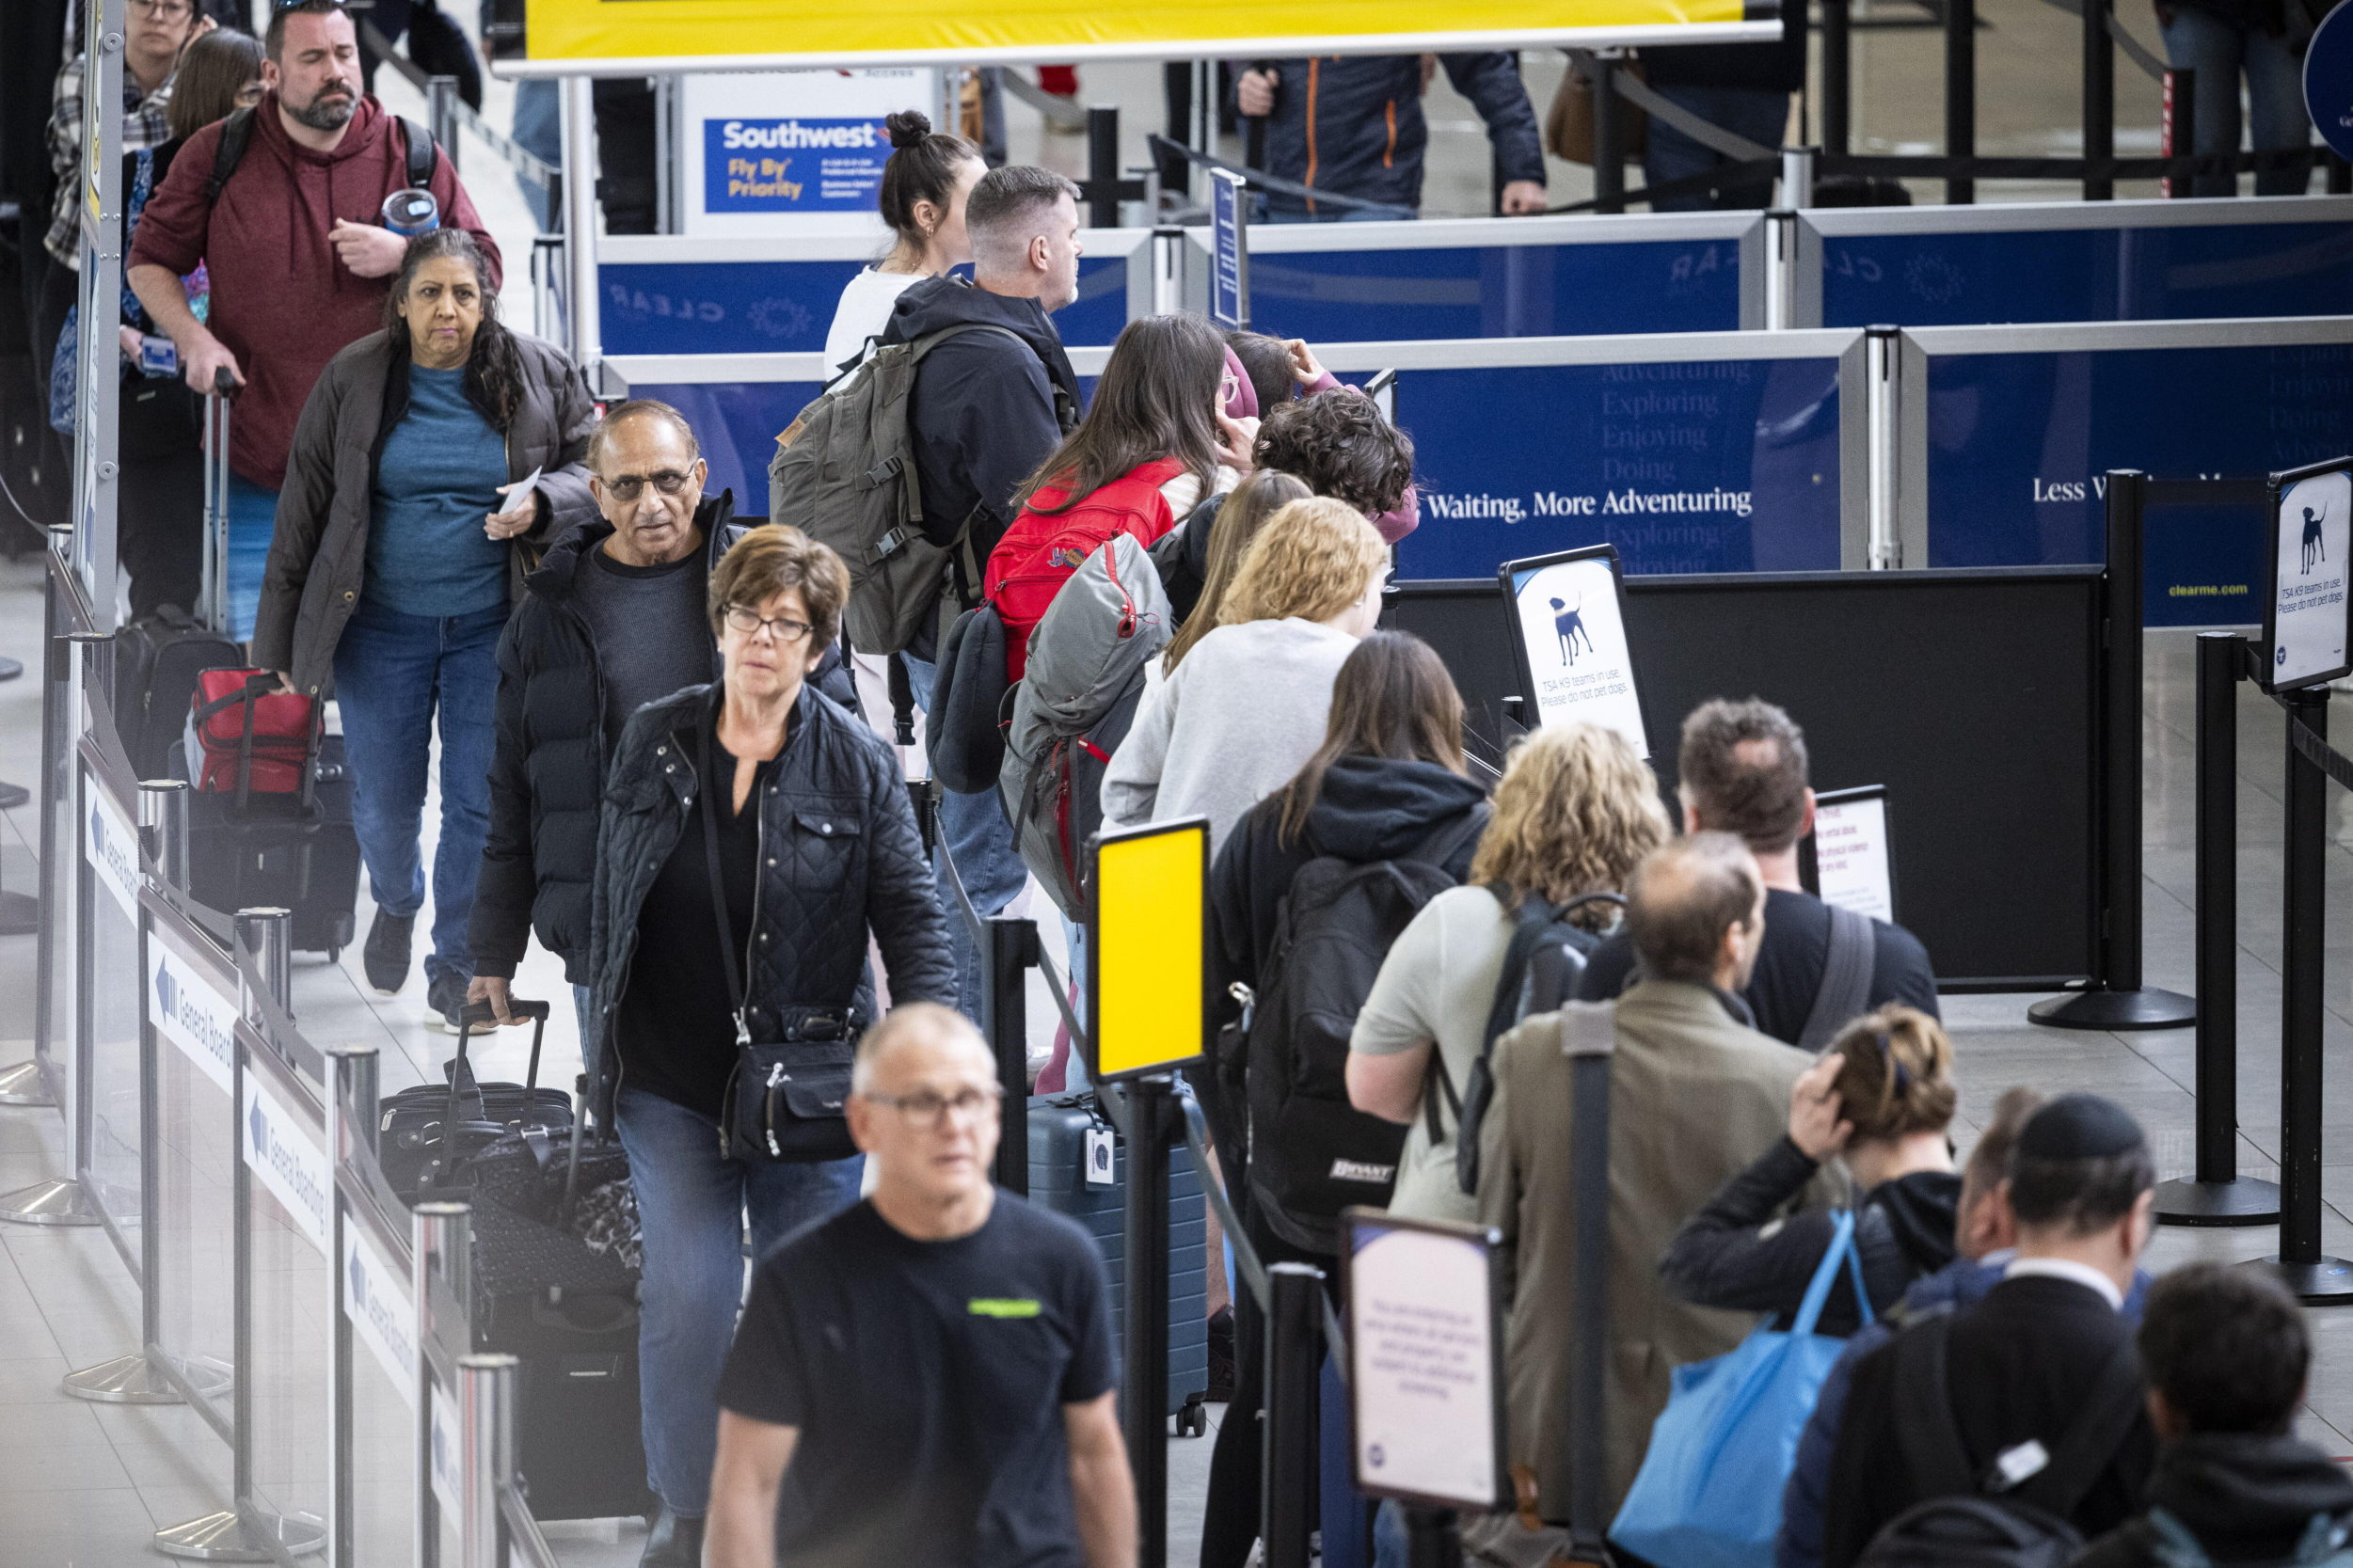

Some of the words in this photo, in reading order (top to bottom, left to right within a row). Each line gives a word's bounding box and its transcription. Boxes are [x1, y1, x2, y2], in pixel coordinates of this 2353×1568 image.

[723, 120, 877, 149] Southwest
[728, 158, 757, 180] Fly
[728, 180, 803, 201] Priority
[1602, 388, 1719, 420] Exploring
[1602, 421, 1708, 453] Enjoying
[1603, 456, 1676, 485] Doing
[2033, 477, 2086, 502] Less
[1427, 493, 1527, 524] Waiting,
[1534, 491, 1597, 516] More
[1602, 486, 1753, 517] Adventuring
[2169, 583, 2248, 596] clearme.com
[2281, 588, 2293, 599] TSA
[2294, 585, 2303, 596] K9
[2304, 582, 2322, 594] teams
[2323, 579, 2329, 590] in
[2278, 602, 2297, 614] Please
[2297, 598, 2306, 610] do
[2307, 596, 2316, 609] not
[2317, 594, 2328, 608] pet
[1543, 680, 1558, 692] TSA
[1560, 676, 1570, 689] K9
[1572, 673, 1596, 687] teams
[1597, 671, 1605, 682] in
[1541, 694, 1566, 707] Please
[1568, 691, 1579, 704] do
[1580, 688, 1594, 701] not
[1595, 685, 1607, 699] pet
[106, 828, 126, 890] General
[180, 988, 208, 1046] General
[209, 1013, 233, 1070] Board
[270, 1127, 294, 1190] General
[295, 1154, 324, 1236] Boarding
